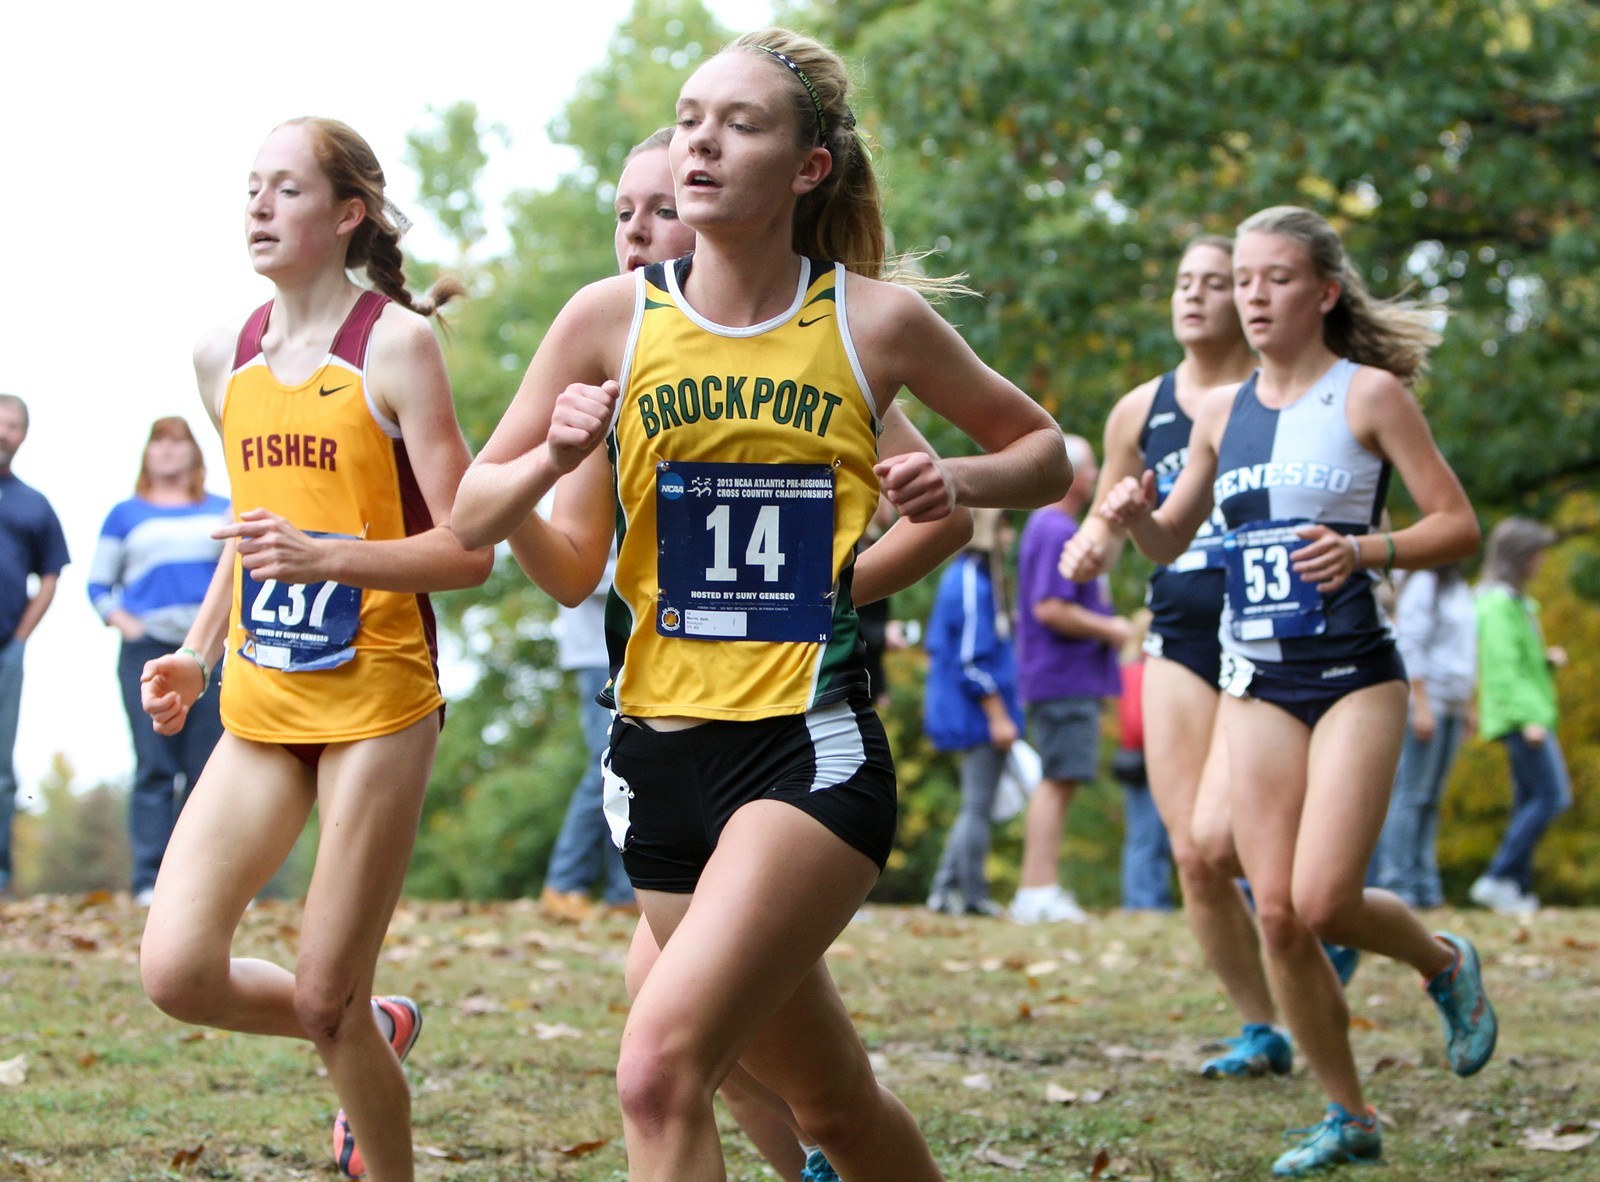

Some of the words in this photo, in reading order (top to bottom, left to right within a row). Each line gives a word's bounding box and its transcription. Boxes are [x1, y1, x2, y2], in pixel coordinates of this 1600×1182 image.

[798, 71, 814, 92] LUCK
[637, 375, 843, 440] BROCKPORT
[241, 433, 338, 472] FISHER
[661, 484, 684, 494] NCAA
[716, 478, 733, 487] 2013
[734, 478, 753, 488] NCAA
[754, 478, 786, 488] ATLANTIC
[786, 479, 833, 488] PRE-REGIONAL
[716, 488, 740, 498] CROSS
[741, 489, 774, 498] COUNTRY
[775, 489, 833, 499] CHAMPIONSHIPS
[706, 505, 785, 582] 14
[1243, 545, 1291, 603] 53
[250, 578, 339, 627] 237
[691, 591, 721, 599] HOSTED
[723, 591, 734, 599] BY
[735, 592, 758, 600] SUNY
[759, 592, 795, 600] GENESEO
[256, 627, 275, 638] HOSTED
[275, 630, 284, 638] BY
[283, 631, 300, 640] SUNY
[300, 632, 329, 643] GENESEO
[819, 633, 827, 641] 14
